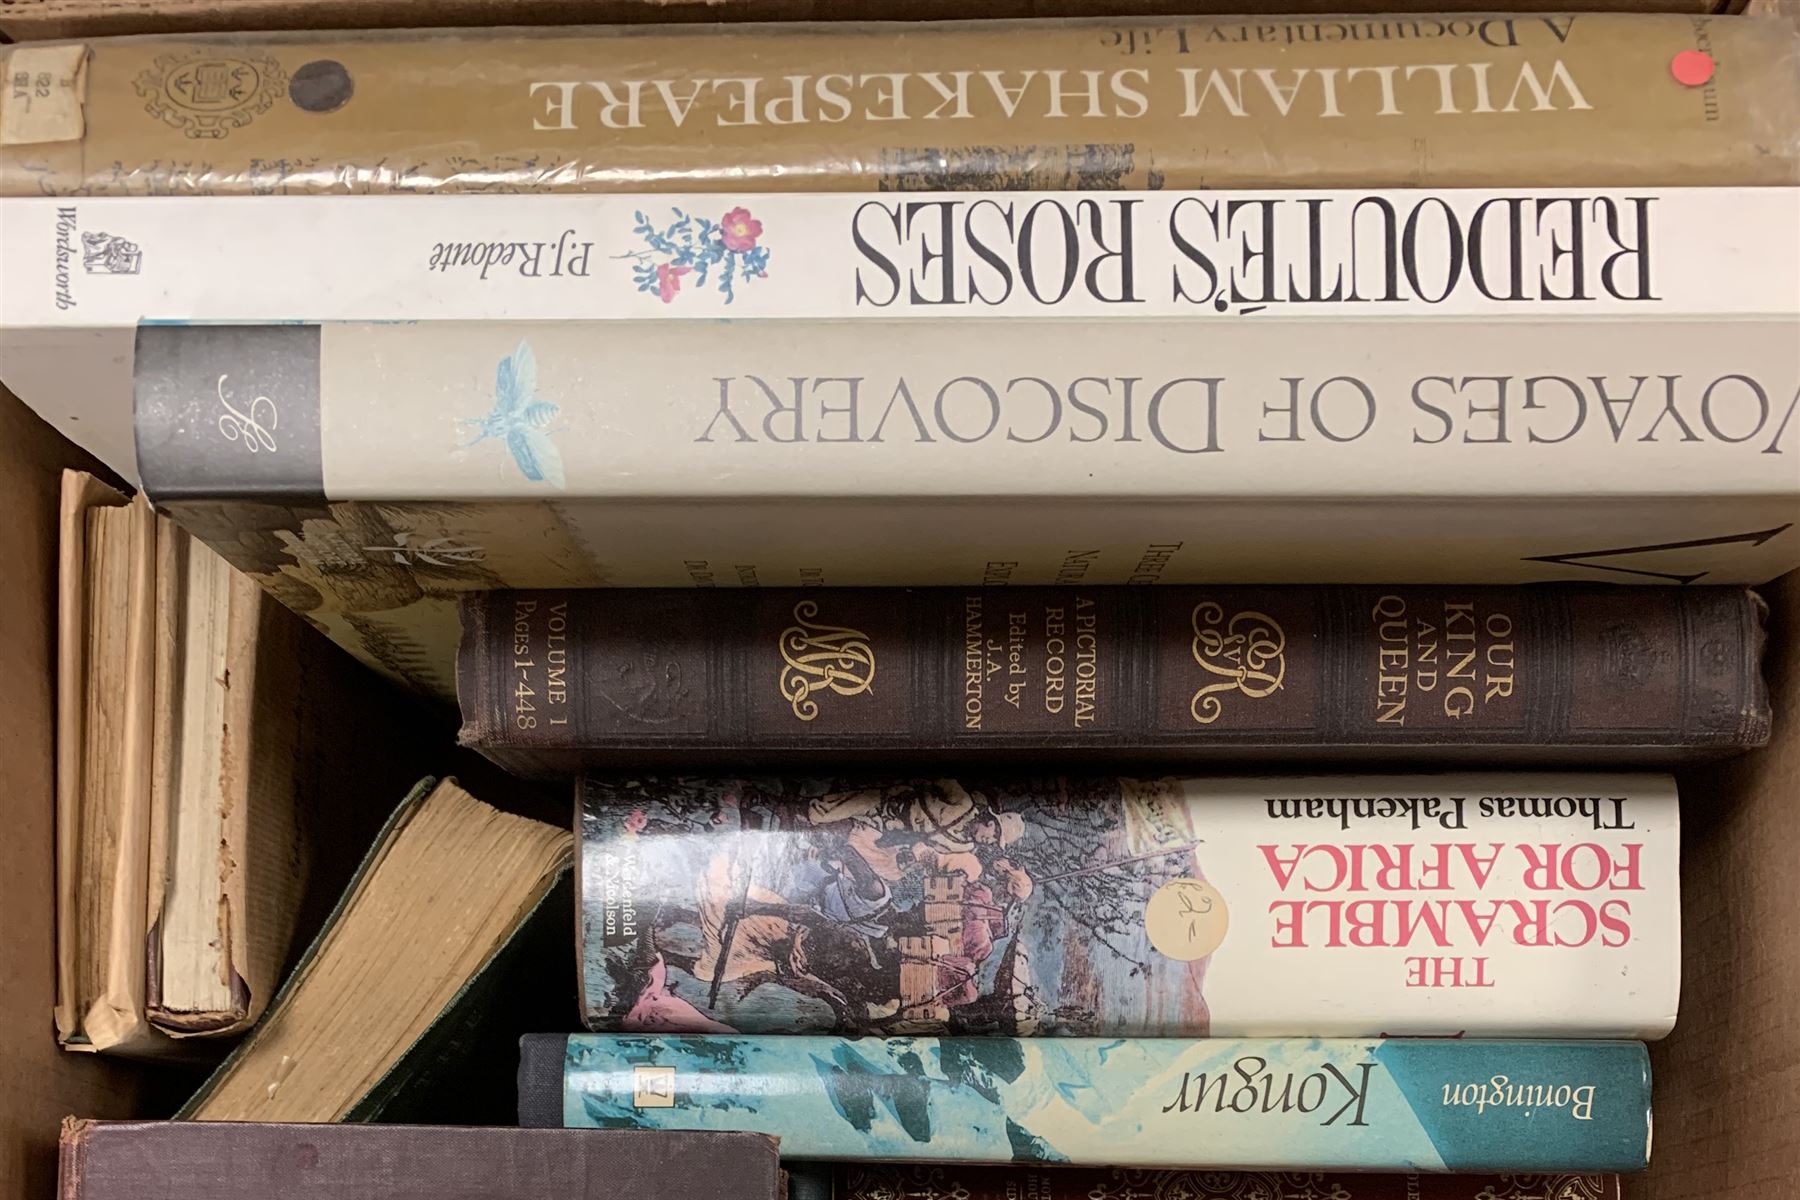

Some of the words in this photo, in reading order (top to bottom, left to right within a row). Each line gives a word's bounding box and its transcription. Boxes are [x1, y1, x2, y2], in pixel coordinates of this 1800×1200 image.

[1100, 27, 1191, 56] Life
[1204, 17, 1521, 48] Documentary
[1540, 16, 1575, 44] A
[528, 66, 1150, 131] SHAKESPEARE
[1177, 59, 1593, 118] WILLIAM
[55, 206, 78, 311] Wordsworth
[851, 198, 1145, 307] ROSES
[1257, 376, 1376, 444] OF
[1075, 597, 1096, 610] A
[547, 602, 568, 705] VOLUME
[965, 596, 983, 731] HAMMERTON
[1008, 613, 1027, 675] Edited
[1045, 607, 1065, 714] RECORD
[1074, 615, 1097, 729] PICTORIAL
[1372, 594, 1409, 728] QUEEN
[1416, 616, 1438, 692] AND
[1443, 602, 1477, 720] KING
[1484, 612, 1514, 704] OUR
[1004, 681, 1027, 709] by
[1265, 797, 1467, 830] Pakenham
[1477, 796, 1635, 830] Thomas
[1257, 842, 1505, 892] AFRICA
[1515, 842, 1645, 892] FOR
[1268, 900, 1632, 949] SCRAMBLE
[1403, 955, 1495, 989] THE
[1162, 1056, 1378, 1127] Kongur
[1441, 1074, 1596, 1121] Bonington
